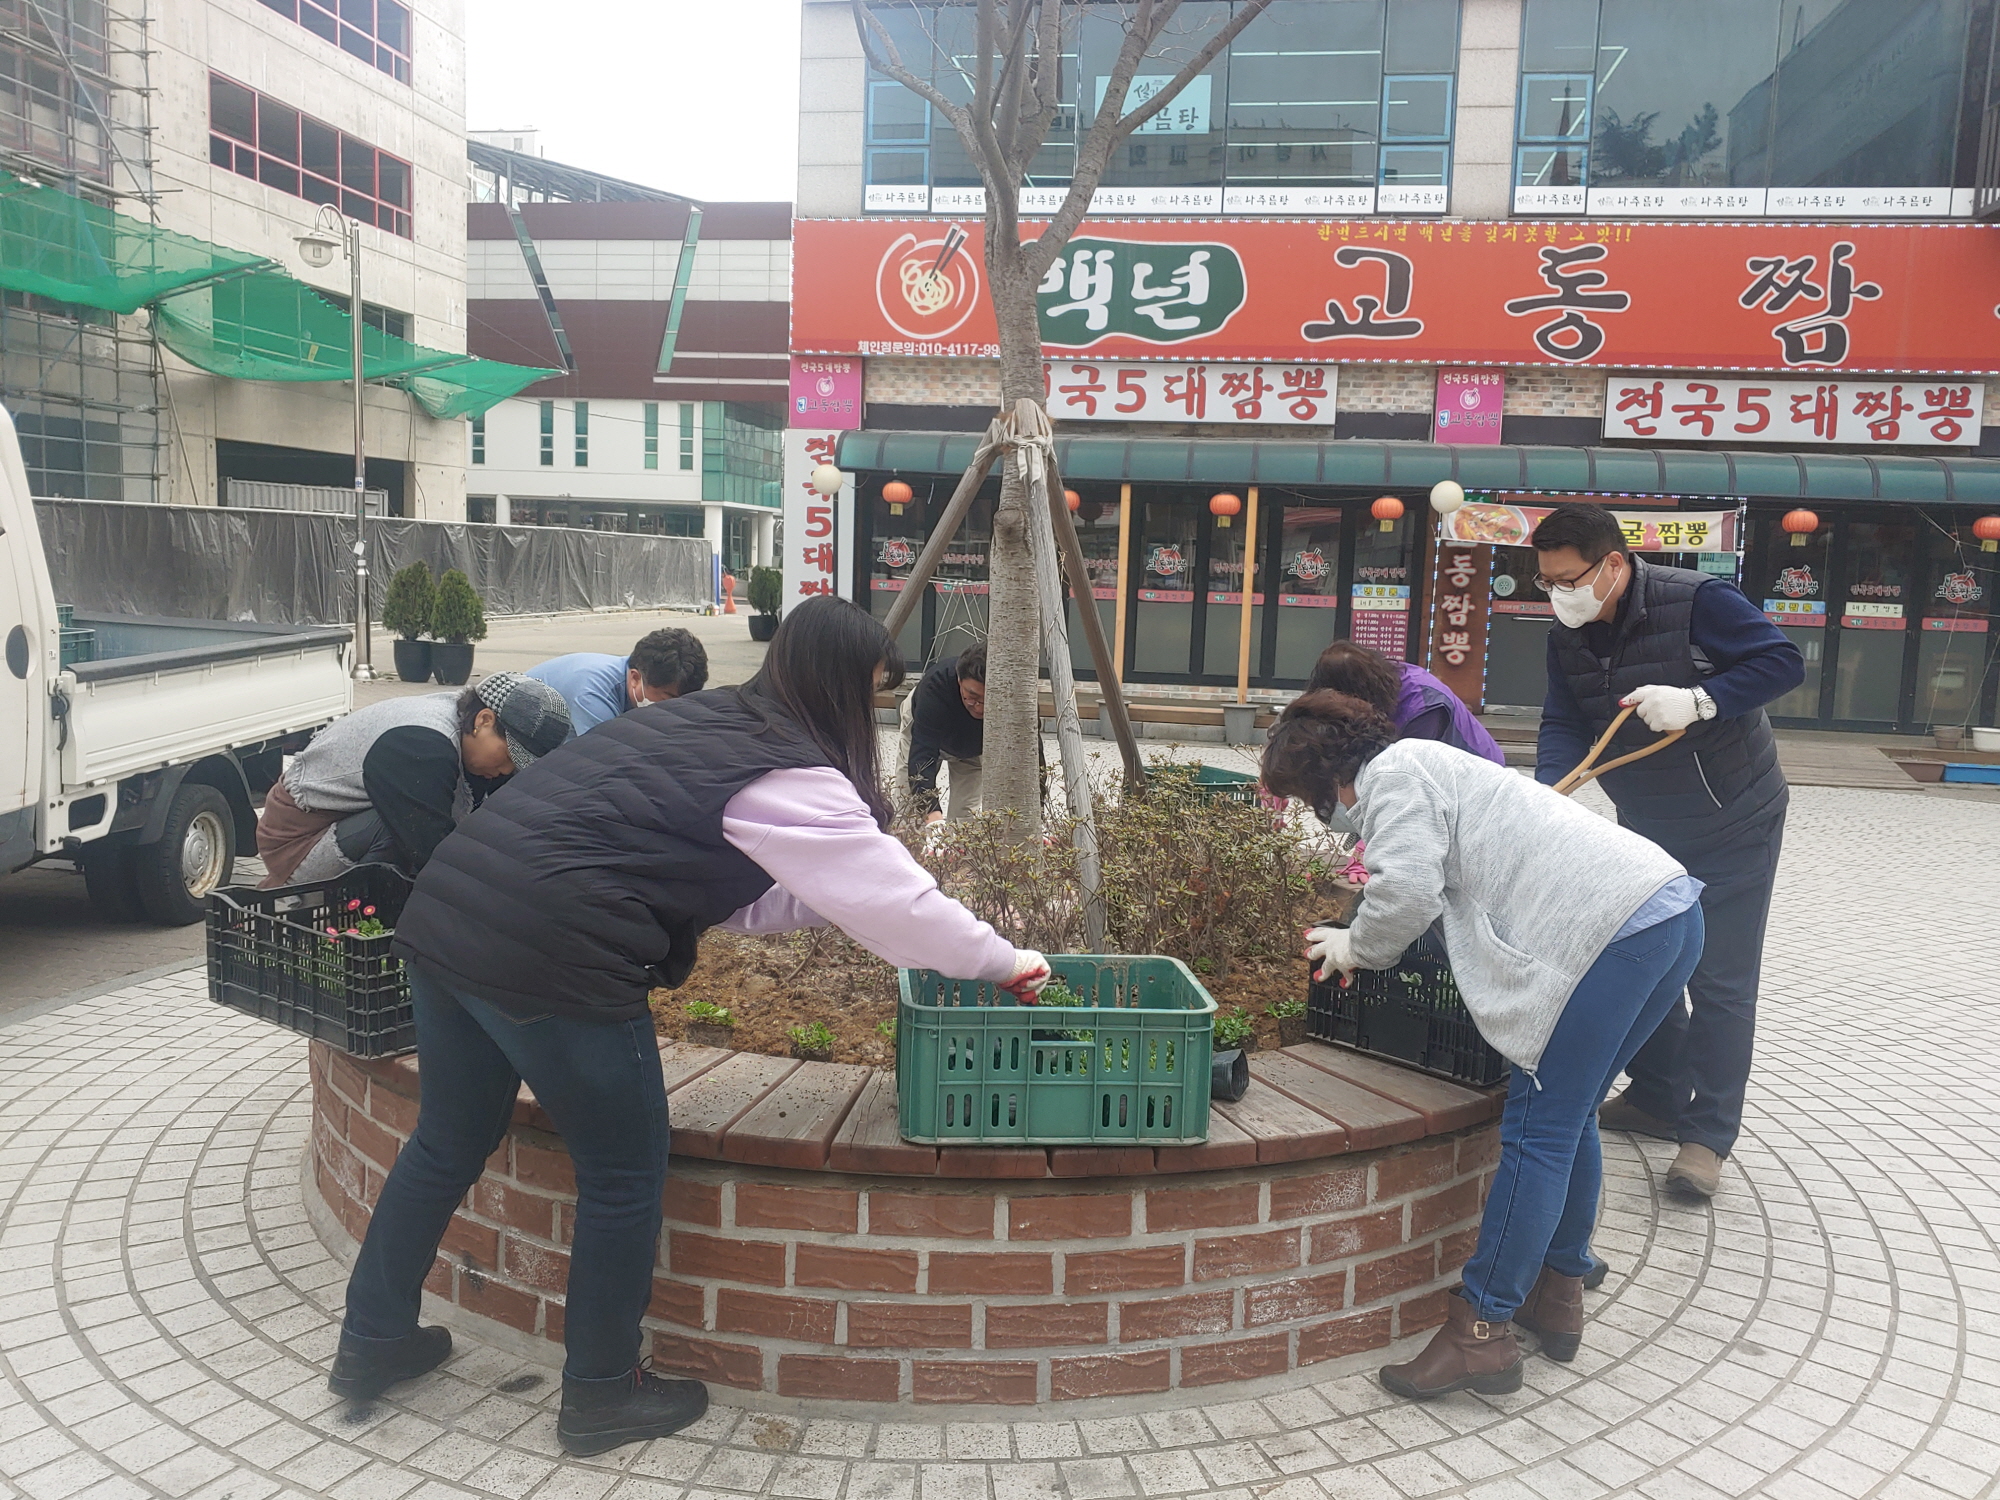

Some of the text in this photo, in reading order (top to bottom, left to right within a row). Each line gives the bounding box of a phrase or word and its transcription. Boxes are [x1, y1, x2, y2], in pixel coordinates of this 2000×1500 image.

[953, 194, 983, 206] 나주곰
[1036, 249, 1210, 332] 백년
[858, 340, 1000, 356] 체인점문의:010-4117-99
[1620, 519, 1709, 548] 굴 짬뽕
[1440, 541, 1478, 666] 동짬뽕
